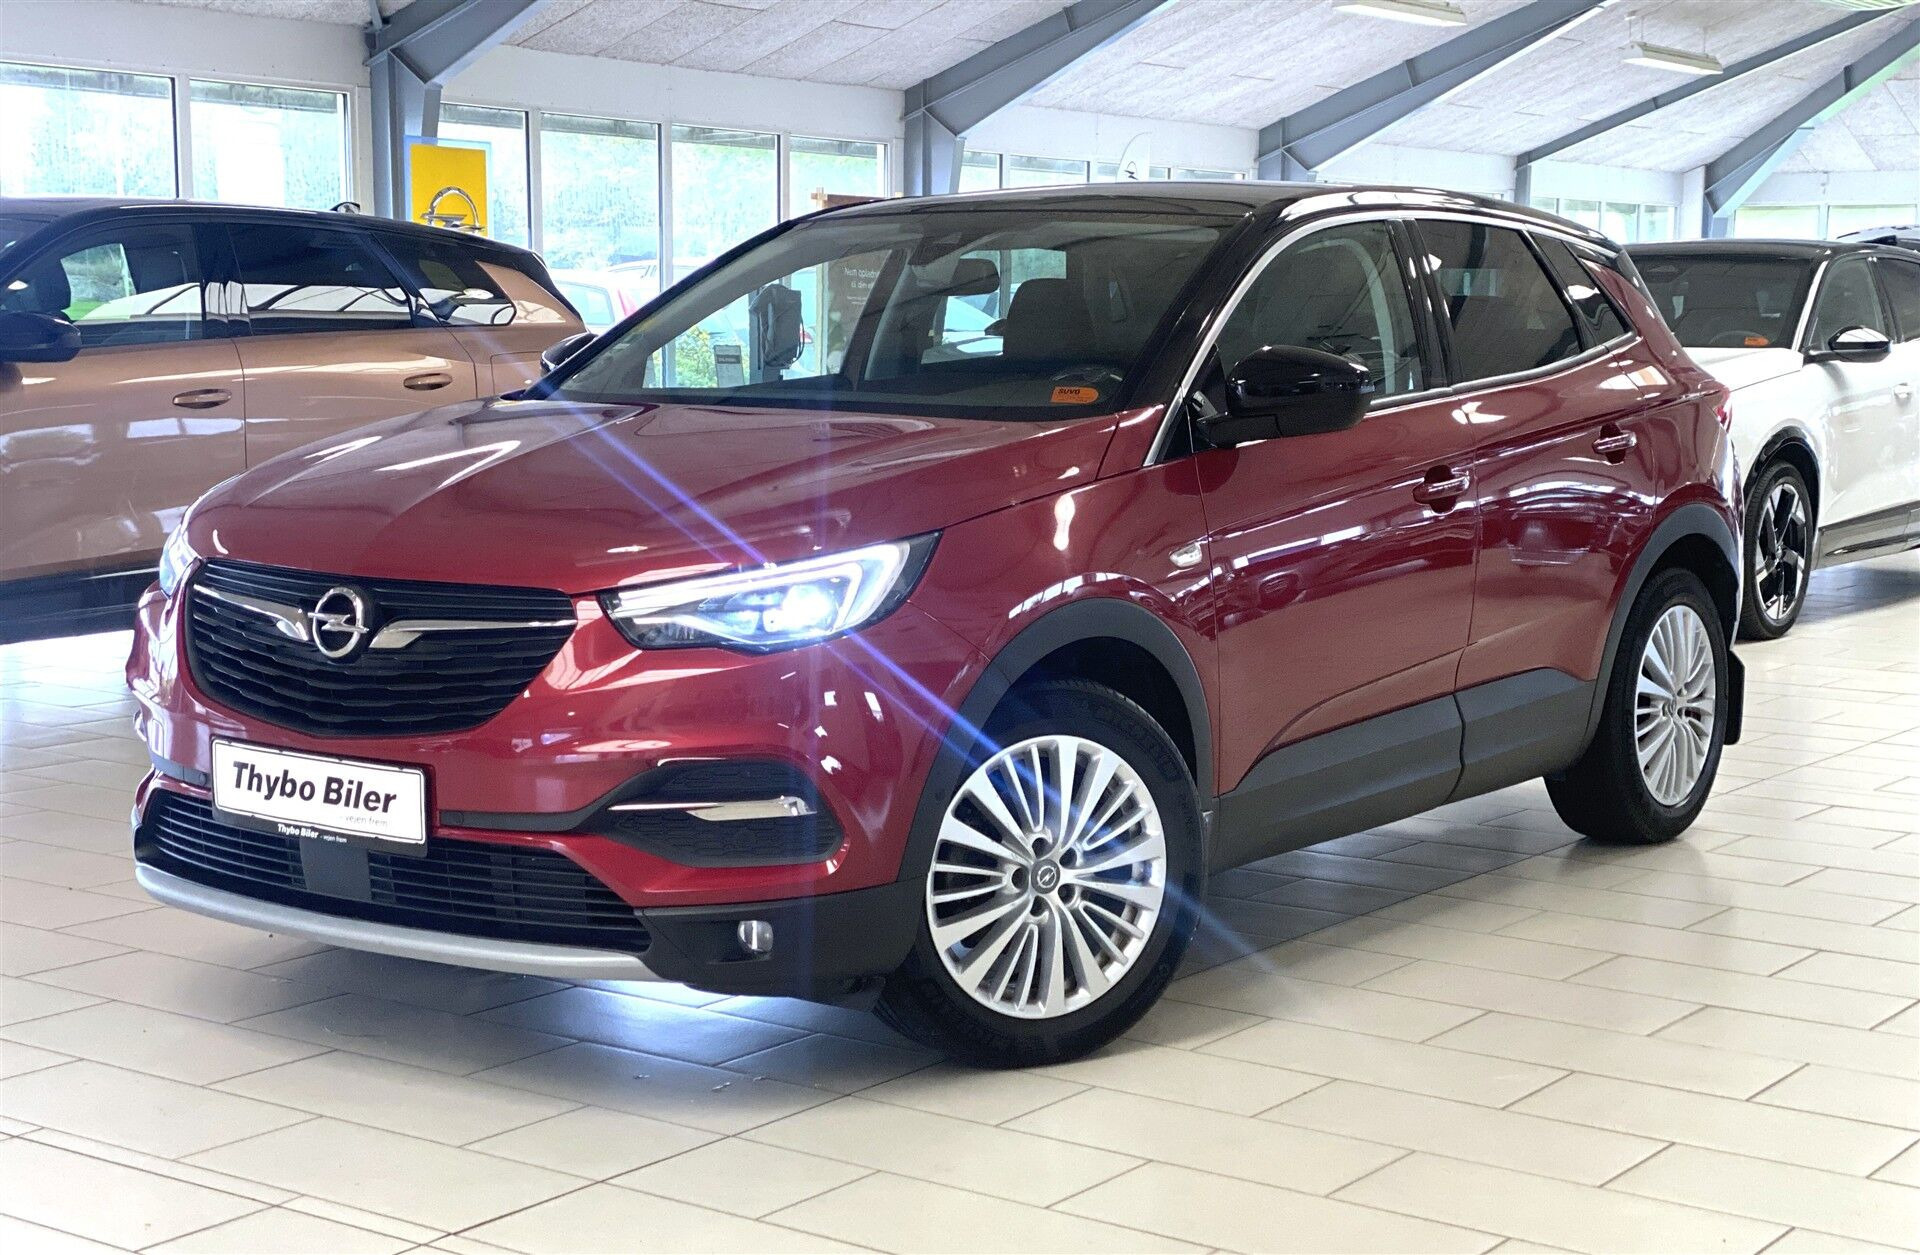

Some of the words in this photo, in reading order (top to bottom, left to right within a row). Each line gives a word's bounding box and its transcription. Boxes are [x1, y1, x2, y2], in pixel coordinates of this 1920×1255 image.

[233, 760, 316, 802] Thybo
[322, 776, 397, 813] Biler
[277, 823, 300, 836] Thybo
[300, 827, 319, 839] Biler
